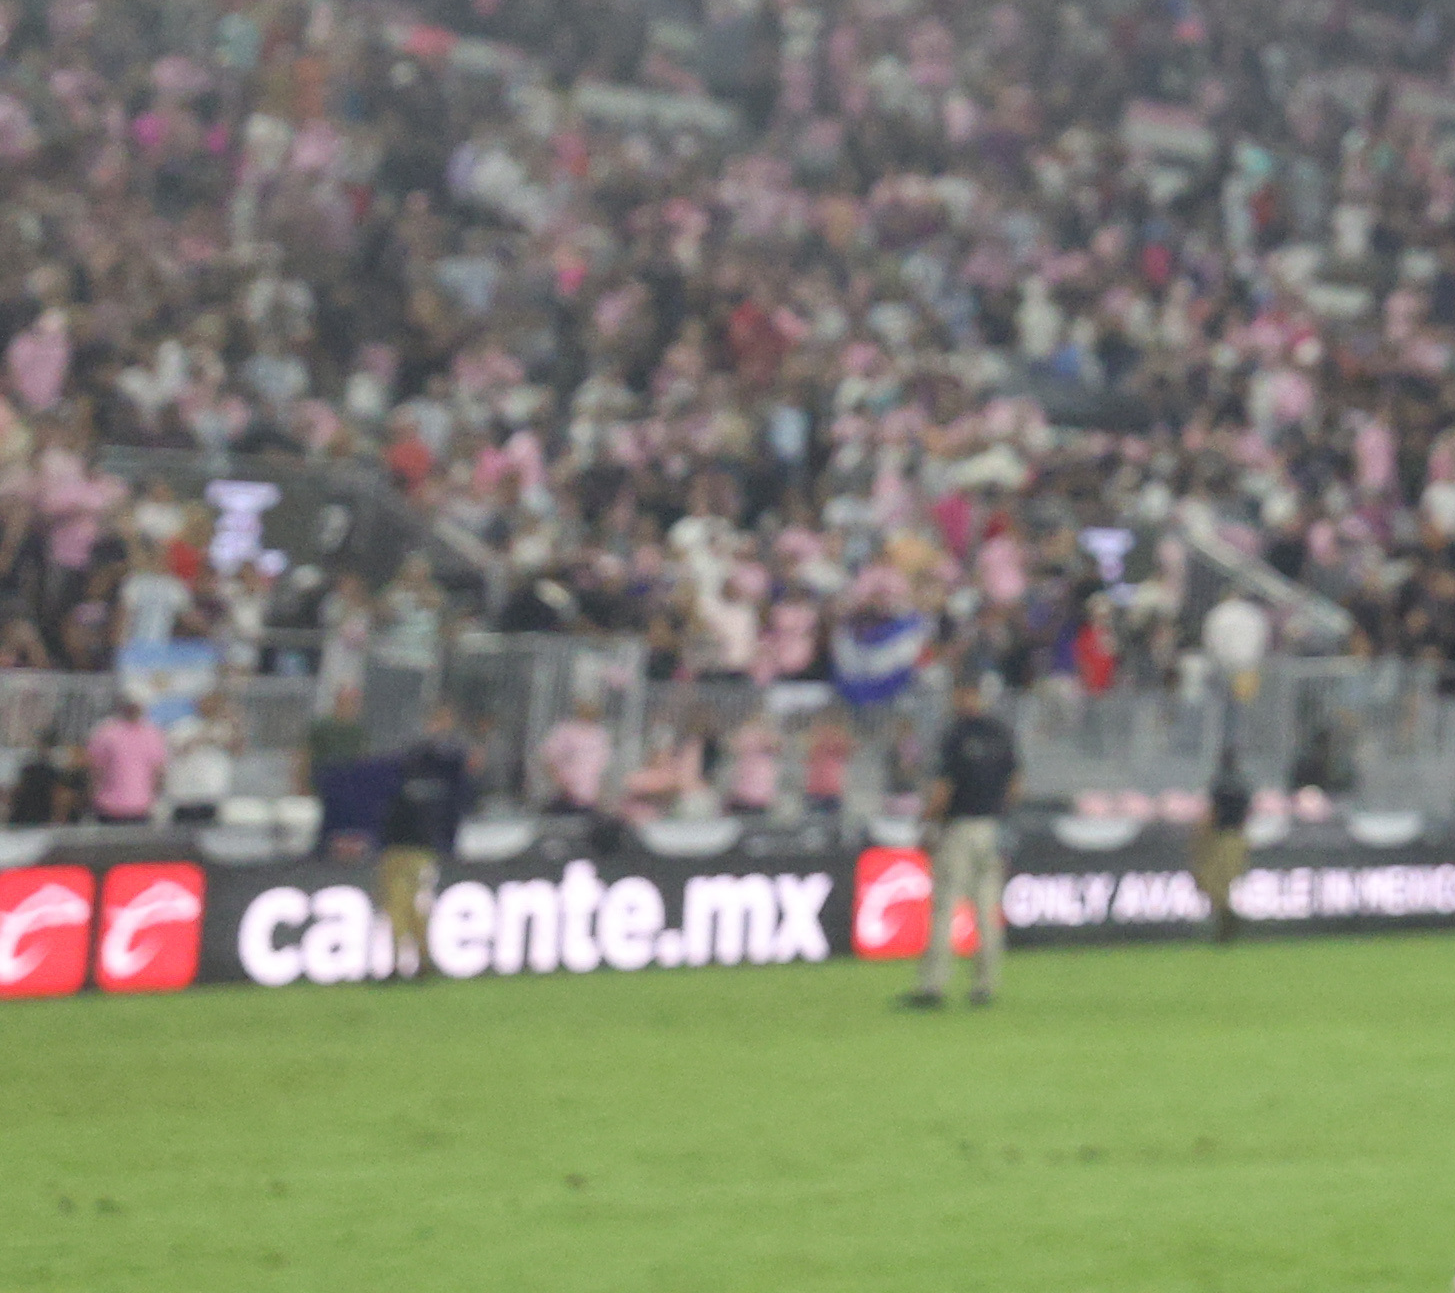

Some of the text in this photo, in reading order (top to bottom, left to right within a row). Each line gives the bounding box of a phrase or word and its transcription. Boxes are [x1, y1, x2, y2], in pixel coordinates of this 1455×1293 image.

[237, 858, 834, 987] caente.mx
[1002, 872, 1115, 927] ONLY
[1111, 867, 1312, 923] AVABLE
